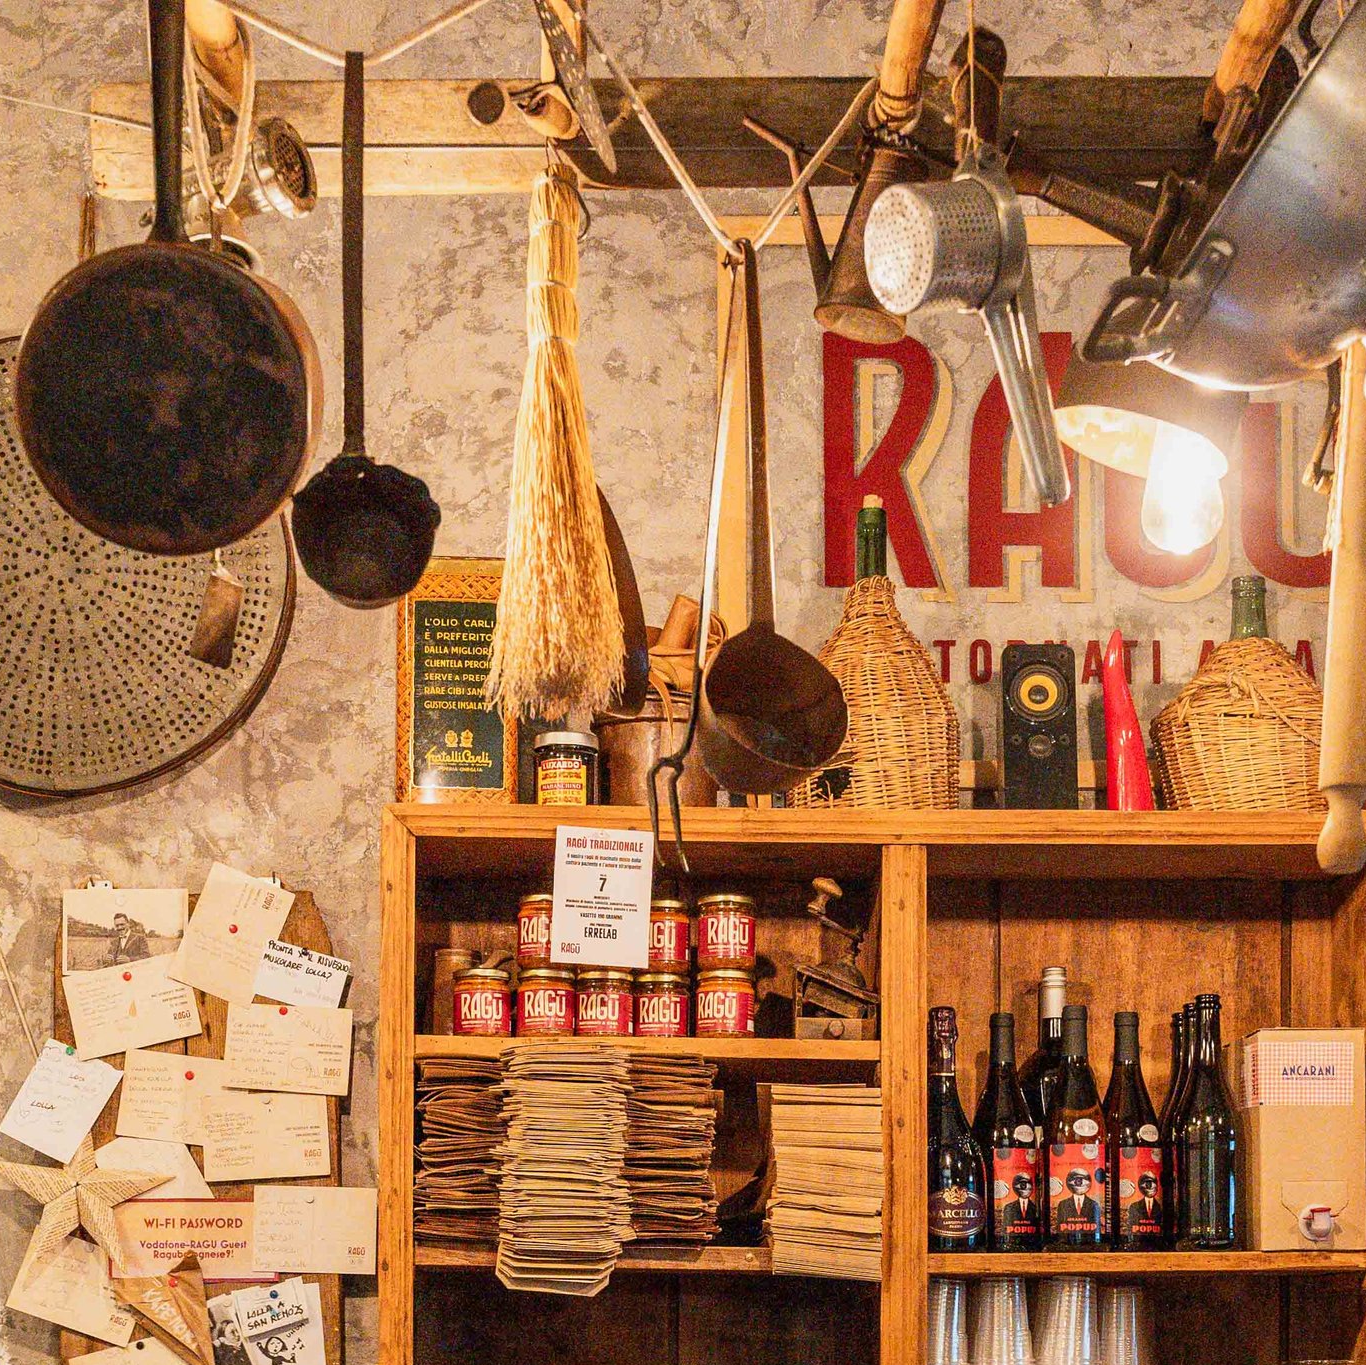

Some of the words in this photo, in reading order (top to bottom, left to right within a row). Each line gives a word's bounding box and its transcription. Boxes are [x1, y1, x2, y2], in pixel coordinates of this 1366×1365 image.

[424, 618, 458, 627] L'OLIO
[464, 619, 494, 628] CARLI
[436, 631, 494, 642] PREFERITO
[424, 646, 449, 655] DALLA
[424, 659, 463, 669] CLIENTELA
[424, 673, 452, 681] SERVE
[424, 686, 446, 695] RARE
[447, 687, 465, 695] CIBI
[424, 701, 457, 710] GUSTOSE
[542, 760, 581, 770] LUXARDO
[590, 839, 643, 852] TRADIZIONALE
[599, 878, 607, 891] 7
[584, 927, 617, 939] ERRELAB
[1282, 1065, 1335, 1075] ANCARANI
[144, 1218, 175, 1229] WI-FI
[180, 1218, 243, 1229] PASSWORD
[1060, 1223, 1097, 1231] POPUP
[140, 1241, 217, 1249] Vodafone-RAGU
[220, 1241, 247, 1249] Guest
[247, 1318, 267, 1330] SAN
